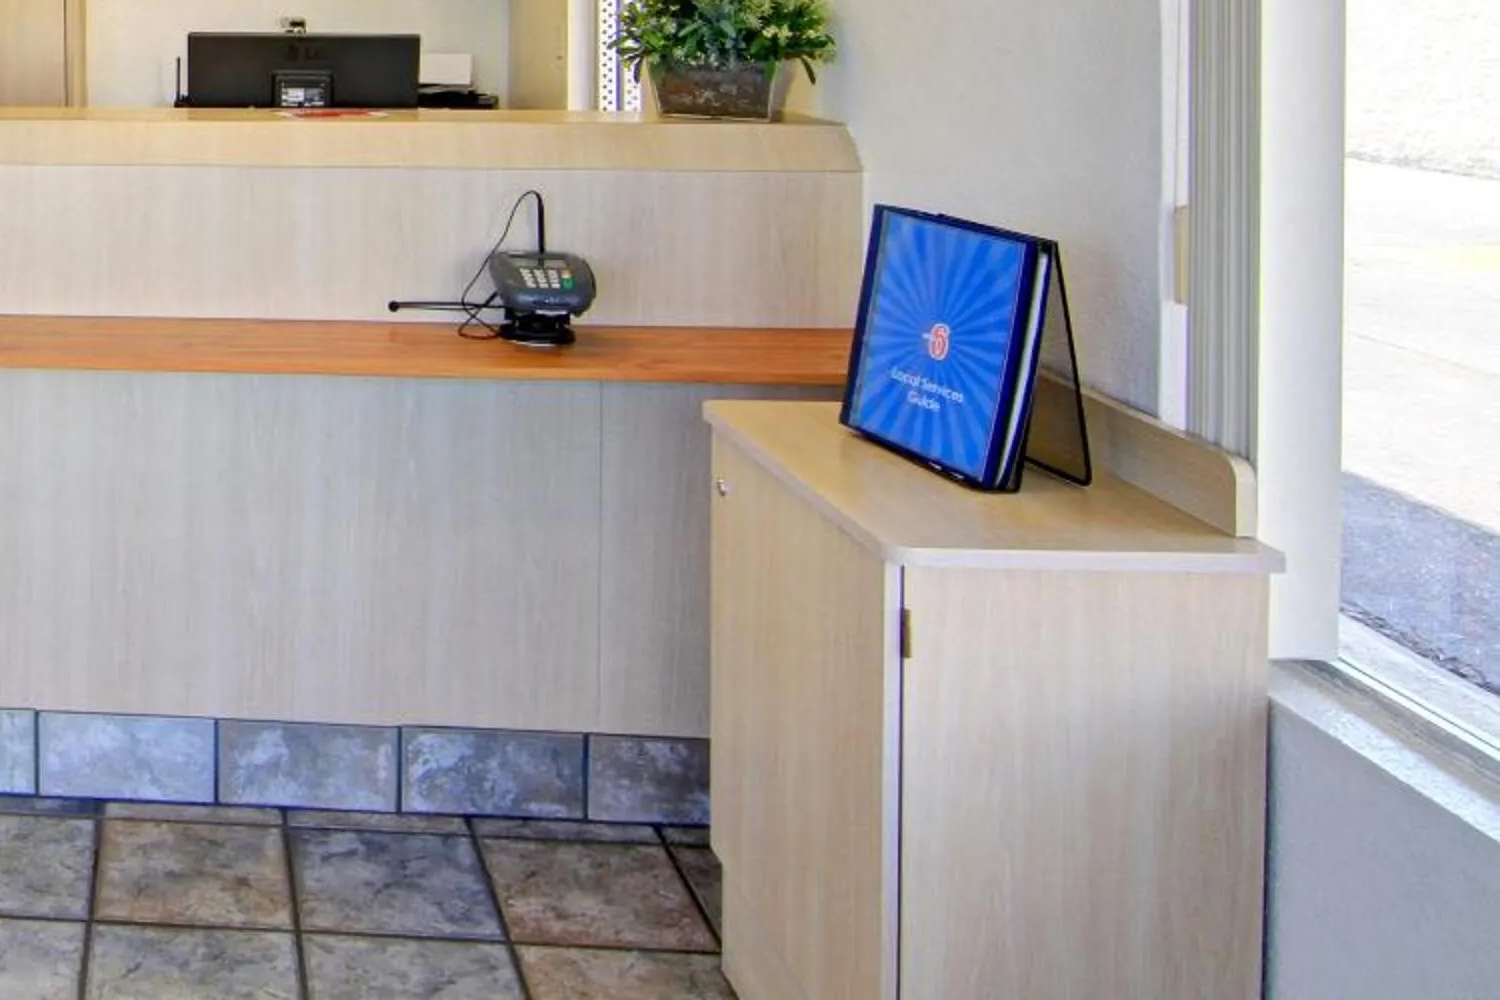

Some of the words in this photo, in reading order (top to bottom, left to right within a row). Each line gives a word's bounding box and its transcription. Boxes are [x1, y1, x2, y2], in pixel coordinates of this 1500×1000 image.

[890, 367, 921, 387] Local
[920, 378, 965, 404] Services
[906, 391, 941, 412] Guide
